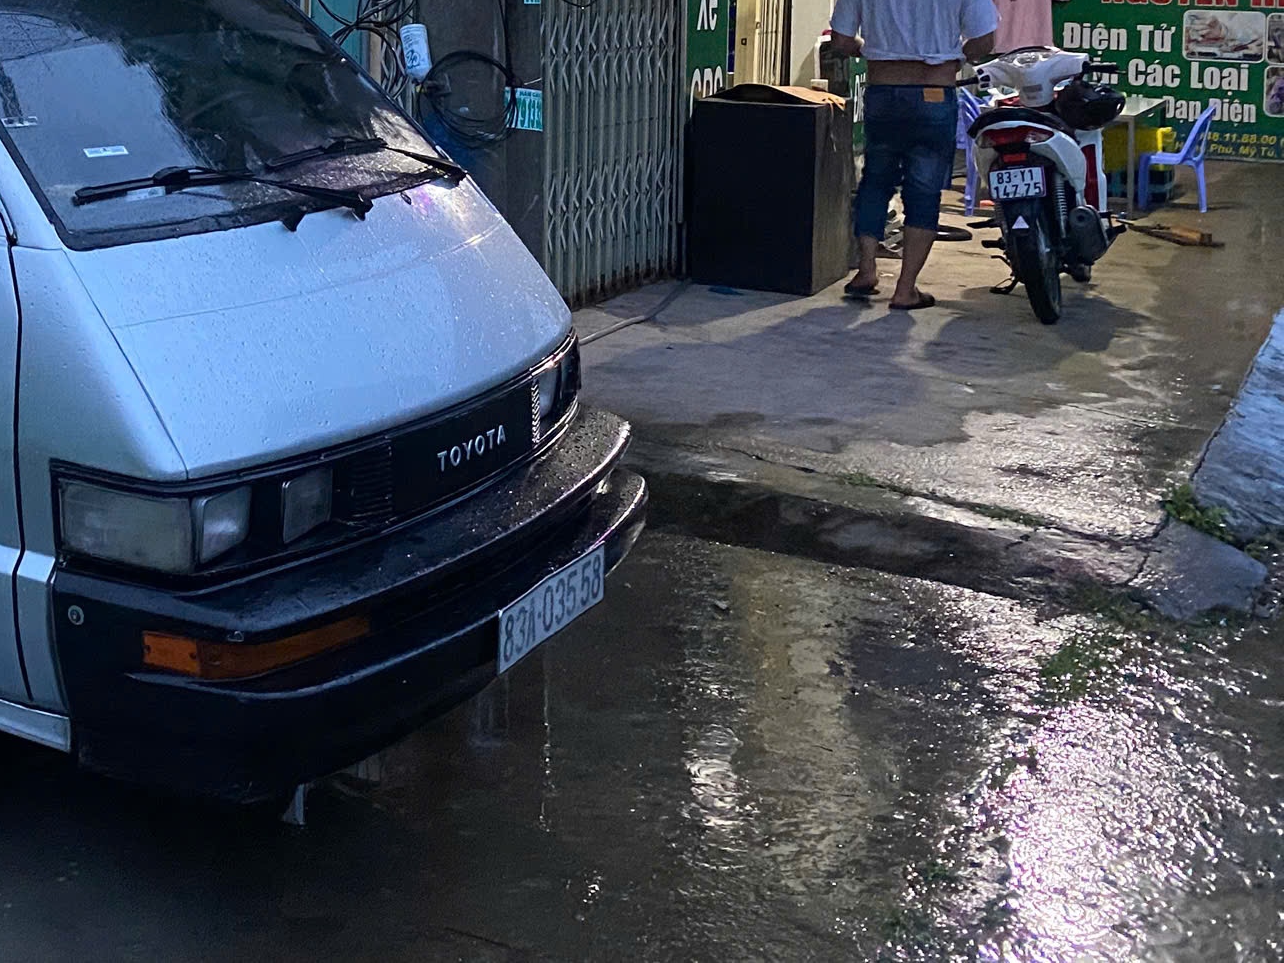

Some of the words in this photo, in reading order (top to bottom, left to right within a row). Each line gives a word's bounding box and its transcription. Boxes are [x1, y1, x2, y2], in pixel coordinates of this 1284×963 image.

[1062, 22, 1127, 55] Điện
[1136, 23, 1176, 52] Tử
[1127, 58, 1181, 87] Các
[1190, 61, 1250, 96] Loại
[996, 169, 1034, 185] 83-Y1
[436, 424, 507, 472] TOYOTA
